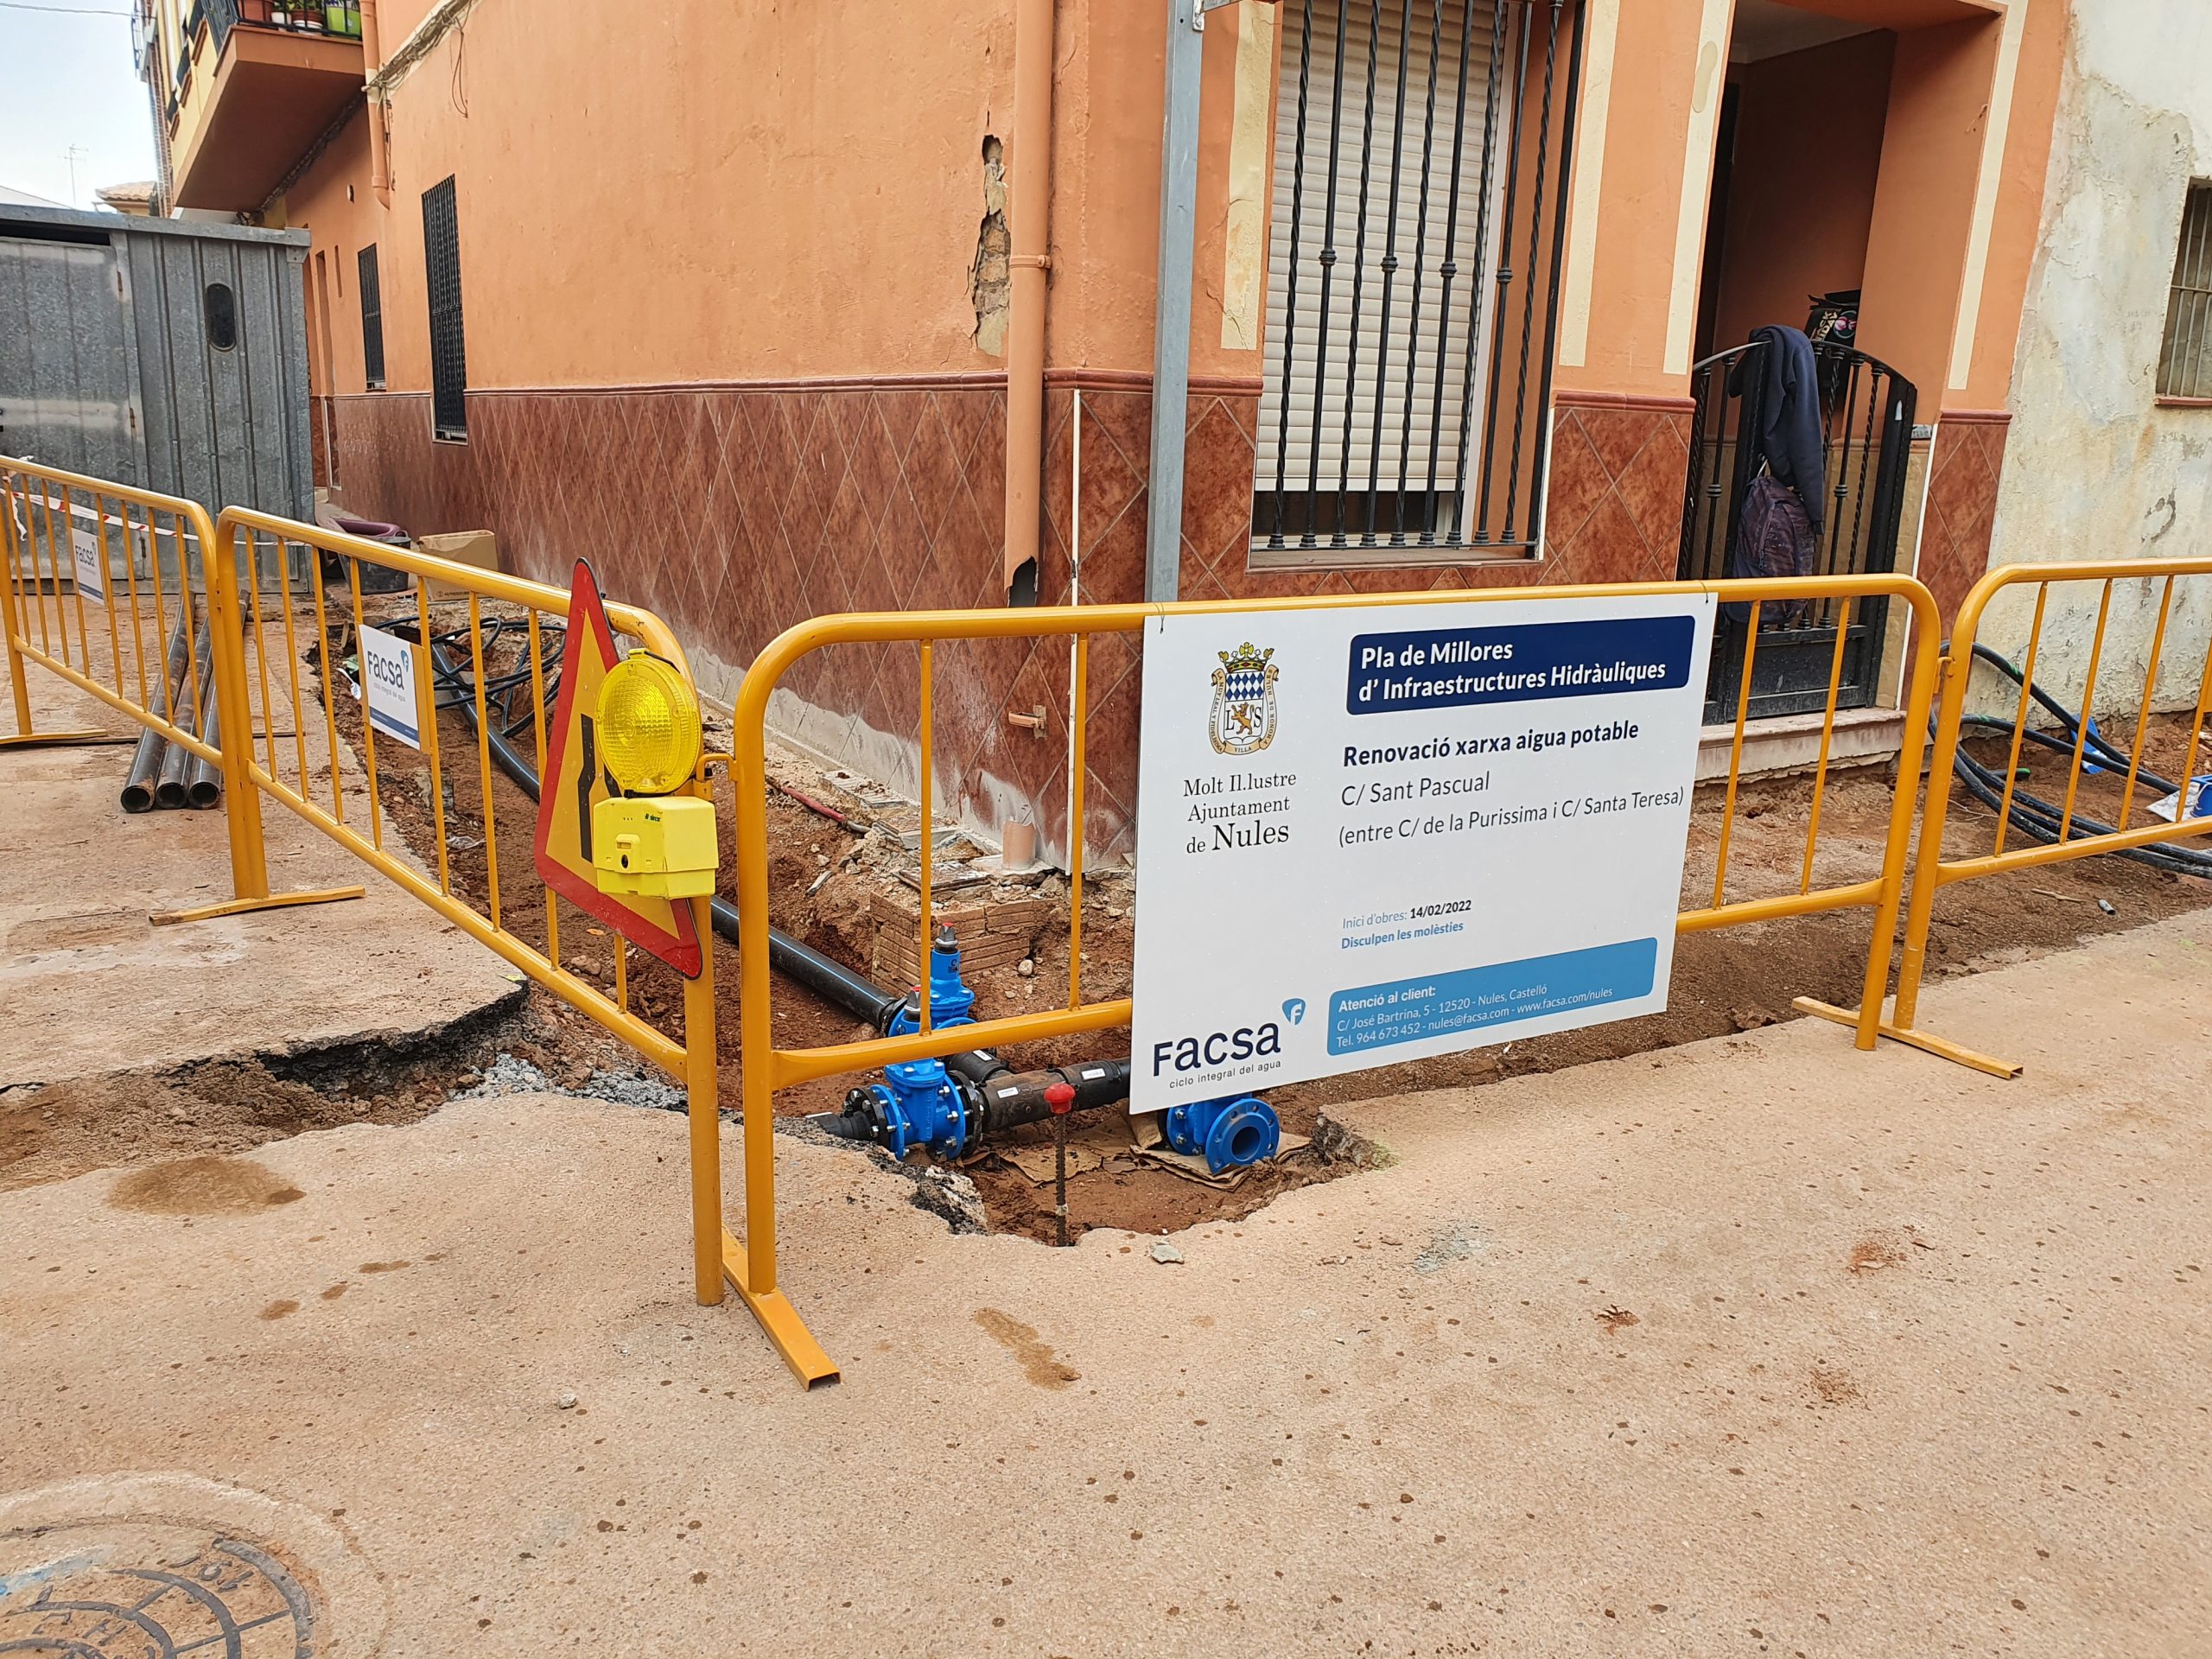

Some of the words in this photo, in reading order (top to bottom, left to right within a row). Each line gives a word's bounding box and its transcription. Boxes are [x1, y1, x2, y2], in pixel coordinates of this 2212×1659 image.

[367, 651, 404, 690] Facsa
[1361, 646, 1395, 670] Pla
[1400, 644, 1426, 666] de
[1430, 640, 1513, 664] Millores
[1383, 671, 1546, 700] Infraestructures
[1550, 661, 1666, 687] Hidràuliques
[1344, 737, 1451, 766] Renovació
[1455, 736, 1511, 756] xarxa
[1516, 728, 1566, 753] aigua
[1570, 720, 1639, 748] potable
[1183, 777, 1224, 797] Molt
[1229, 772, 1296, 791] Il.lustre
[1341, 784, 1365, 806] C/
[1370, 781, 1413, 803] Sant
[1420, 771, 1490, 798] Pascual
[1187, 796, 1290, 824] Ajuntament
[1339, 824, 1393, 848] (entre
[1398, 817, 1421, 837] C/
[1423, 816, 1445, 835] de
[1449, 813, 1464, 832] la
[1469, 805, 1548, 830] Purissima
[1553, 801, 1557, 819] i
[1561, 798, 1581, 817] C/
[1584, 795, 1627, 815] Santa
[1631, 785, 1684, 809] Teresa)
[1186, 836, 1206, 854] de
[1211, 819, 1289, 851] Nules
[1343, 915, 1364, 929] Inici
[1410, 899, 1472, 919] 14/02/2022
[1341, 932, 1395, 950] Disculpen
[1396, 930, 1412, 941] les
[1414, 921, 1464, 938] molèsties
[1337, 1019, 1350, 1032] C/
[1351, 1014, 1375, 1030] José
[1376, 1008, 1421, 1025] Bartrina,
[1423, 1005, 1430, 1016] 5
[1439, 997, 1471, 1014] 12520
[1478, 993, 1507, 1007] Nules,
[1509, 983, 1548, 1000] Castelló
[1338, 994, 1383, 1013] Atenció
[1387, 991, 1398, 1004] al
[1401, 985, 1436, 1001] client:
[1336, 1035, 1354, 1048] Tel.
[1357, 1030, 1376, 1045] 964
[1378, 1026, 1399, 1039] 673
[1400, 1022, 1421, 1035] 452
[1428, 1008, 1510, 1031] nules@facsa.com
[1516, 987, 1613, 1014] www.facsa.com/nules
[1154, 1022, 1281, 1077] Facsa
[1169, 1075, 1194, 1089] ciclo
[1198, 1067, 1236, 1083] integral
[1239, 1064, 1254, 1075] del
[1257, 1060, 1281, 1072] agua
